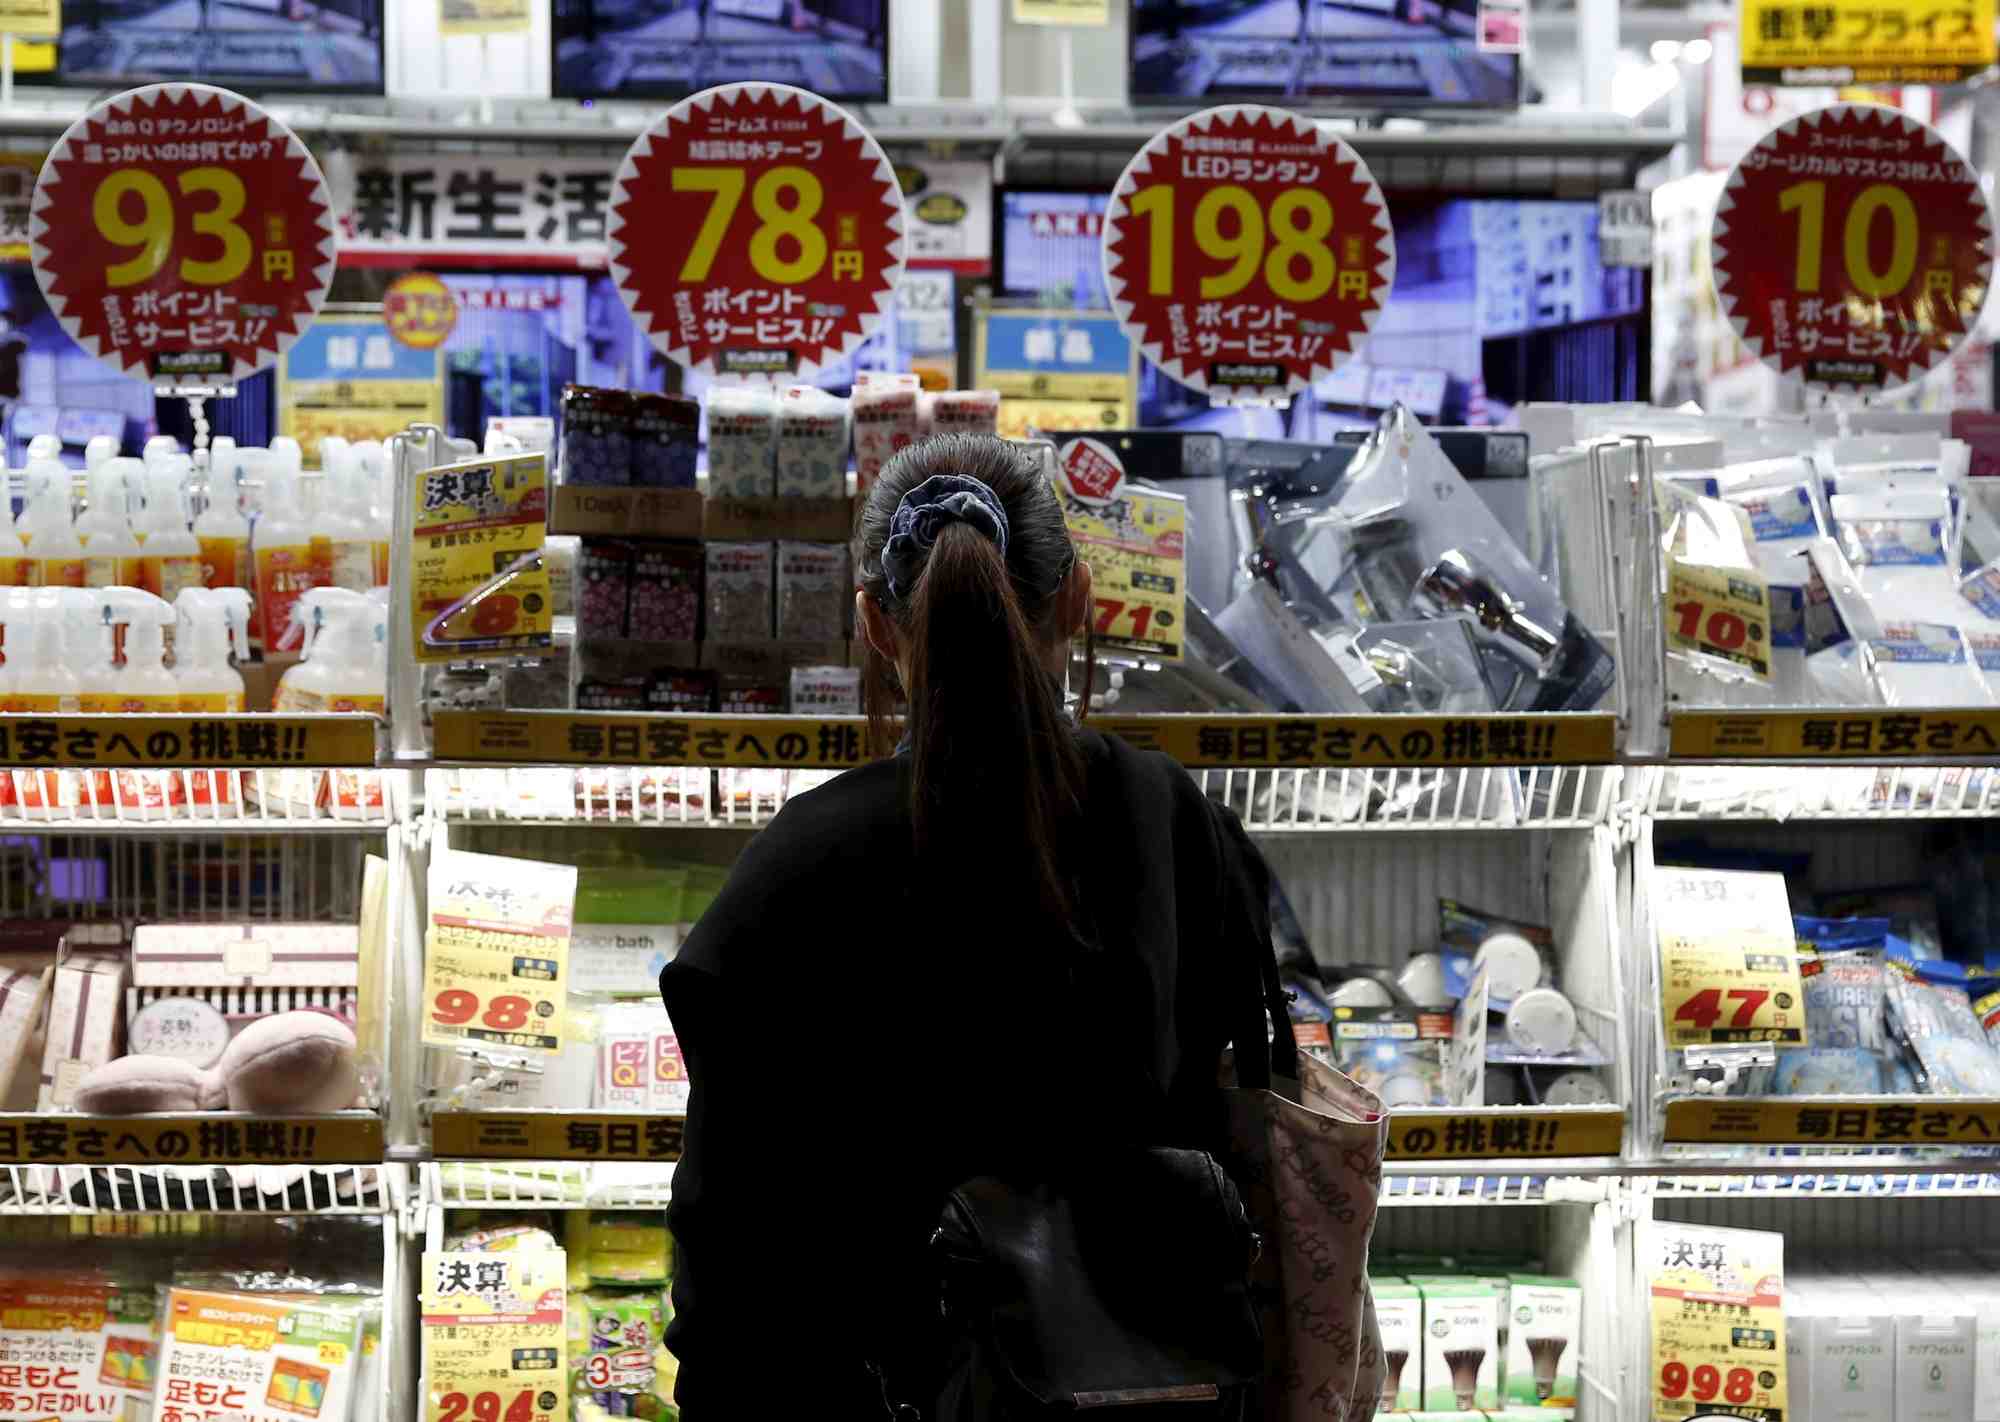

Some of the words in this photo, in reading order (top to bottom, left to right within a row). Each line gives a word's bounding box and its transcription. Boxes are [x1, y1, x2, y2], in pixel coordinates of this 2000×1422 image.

[1182, 156, 1320, 183] LEDランタン
[357, 170, 612, 240] 新生活
[93, 167, 252, 287] 93
[264, 252, 294, 280] 円
[672, 166, 827, 284] 78
[833, 251, 864, 282] 円
[1130, 184, 1337, 301] 198
[1338, 271, 1368, 300] 円
[1779, 180, 1918, 298] 10
[133, 290, 238, 316] ポイント
[704, 288, 806, 313] ポイント
[1197, 303, 1296, 327] ポイント
[133, 320, 268, 347] サービス!!
[704, 318, 834, 344] サービス!!
[1197, 332, 1323, 360] サービス!!
[425, 468, 493, 507] 決算
[1674, 601, 1746, 649] 10
[0, 722, 307, 761] 安さへの挑戦!!
[568, 722, 862, 762] 毎日安さへの挑
[1198, 719, 1556, 762] 毎日安さへの挑戦!!
[1802, 714, 1997, 751] 毎日安さへ
[432, 990, 532, 1030] 98
[1673, 988, 1770, 1029] 47
[1386, 1117, 1560, 1153] の挑戦!!
[1663, 1242, 1728, 1271] 決算
[437, 1261, 508, 1293] 決算
[0, 1366, 78, 1390] 足もと
[164, 1378, 246, 1411] 足もと
[1661, 1361, 1755, 1405] 998
[0, 1391, 116, 1414] あったかい!
[437, 1390, 535, 1422] 294
